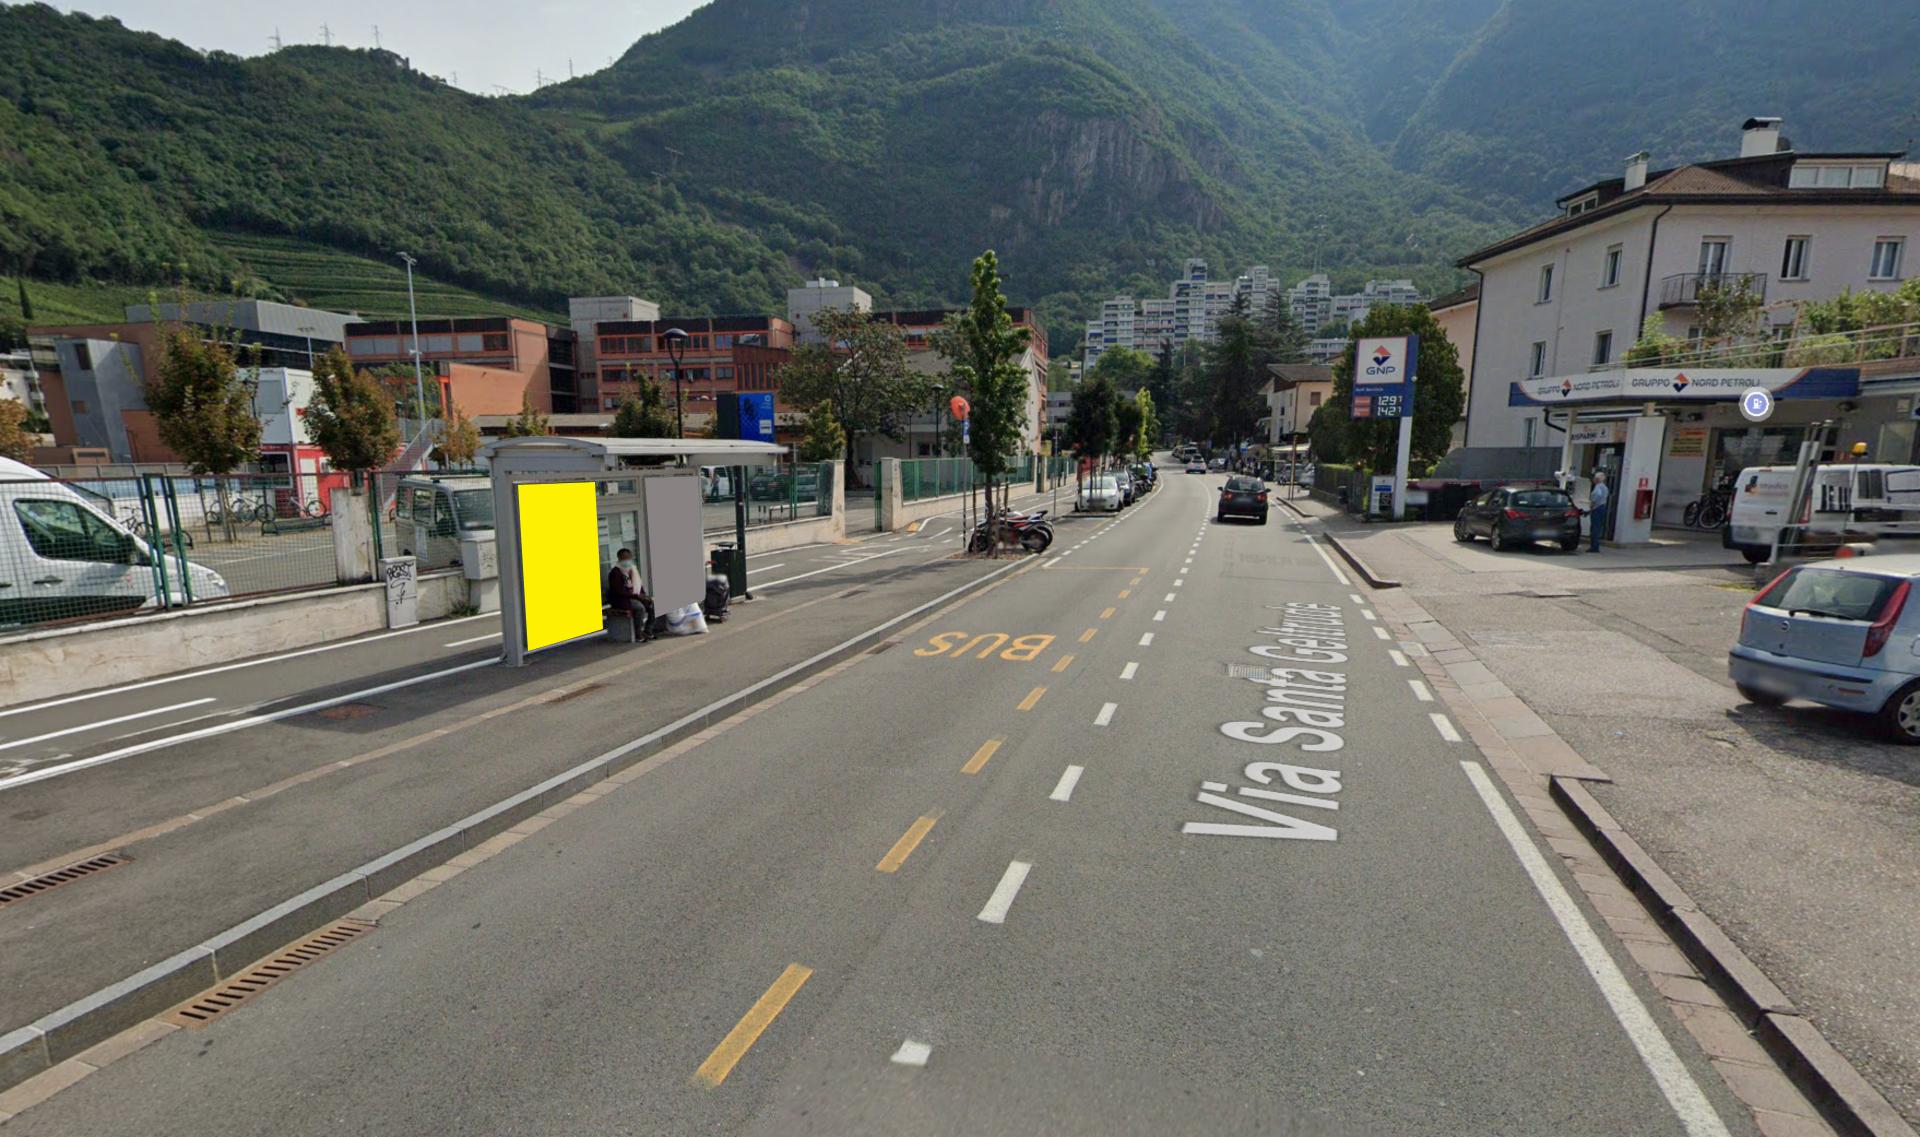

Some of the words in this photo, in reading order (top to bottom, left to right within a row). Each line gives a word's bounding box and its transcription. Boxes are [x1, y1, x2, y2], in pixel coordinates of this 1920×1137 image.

[1366, 366, 1396, 375] GNP
[1631, 378, 1671, 387] GRUPPO
[1691, 378, 1719, 387] NORD
[1720, 378, 1761, 387] PETROLI
[913, 631, 1057, 661] BUS
